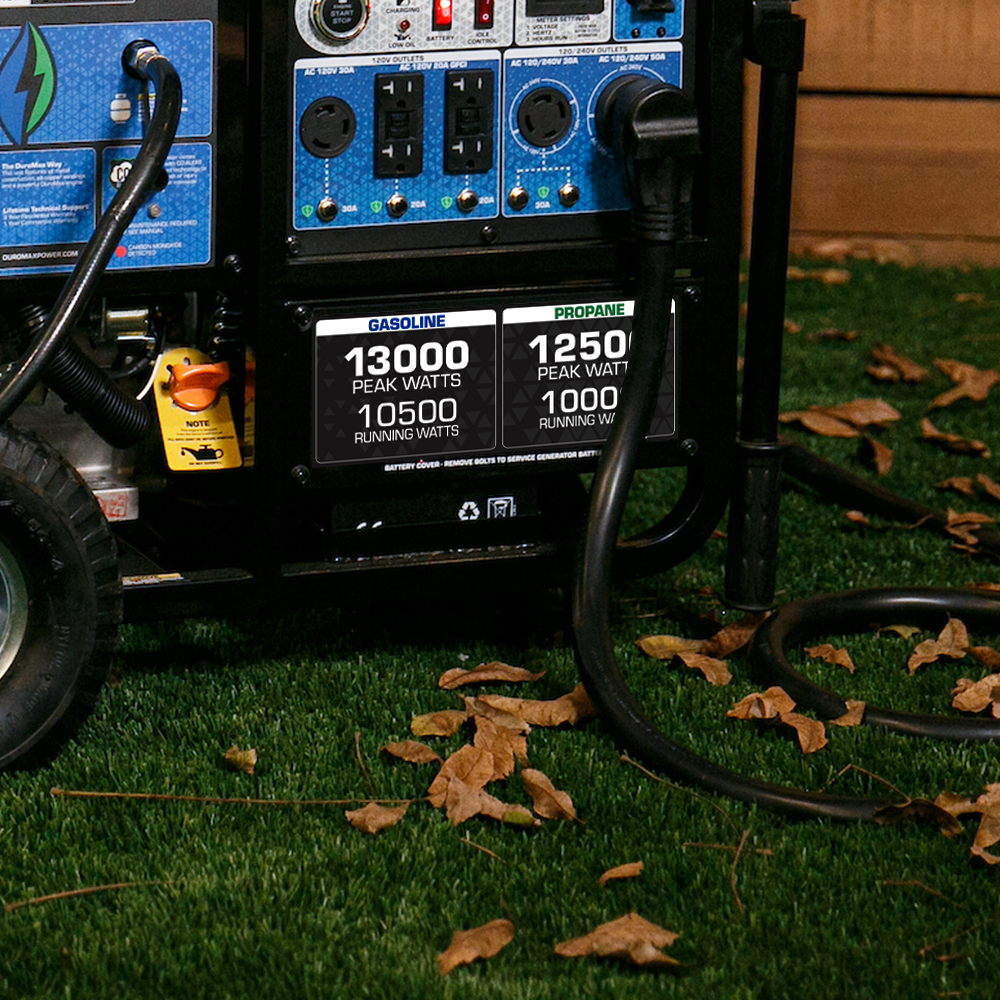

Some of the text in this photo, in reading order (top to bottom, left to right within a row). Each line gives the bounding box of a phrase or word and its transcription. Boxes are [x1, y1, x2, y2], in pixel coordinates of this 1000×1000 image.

[559, 47, 595, 55] 120/240V
[372, 55, 425, 64] 120V OUTLETS
[510, 57, 579, 67] AC 120/240V 30A
[611, 54, 650, 63] 120/240V
[650, 53, 666, 61] 50A
[304, 66, 355, 76] AC 120V 30A
[412, 63, 432, 71] 120V
[433, 62, 449, 70] 20A
[30, 205, 61, 213] Technical
[62, 204, 89, 212] Support
[342, 205, 358, 213] 30A
[410, 201, 427, 209] 20A
[534, 201, 551, 209] 30A
[2, 250, 79, 261] DUROMAXPOWER.COM
[554, 303, 625, 319] PROPANE
[368, 314, 446, 332] GASOLINE
[528, 330, 633, 364] 1250
[344, 340, 469, 377] 13000
[538, 361, 629, 381] PEAK WATT
[353, 373, 461, 394] PEAK WATTS
[541, 386, 623, 414] 1000
[358, 398, 457, 428] 10500
[539, 414, 596, 429] RUNNING
[354, 425, 459, 444] RUNNING WATTS
[384, 462, 416, 471] BATTERY
[416, 460, 440, 469] COVER
[443, 458, 474, 467] REMOVE
[474, 457, 496, 465] BOLTS
[507, 454, 536, 463] SERVICE
[536, 451, 577, 461] GENERATOR
